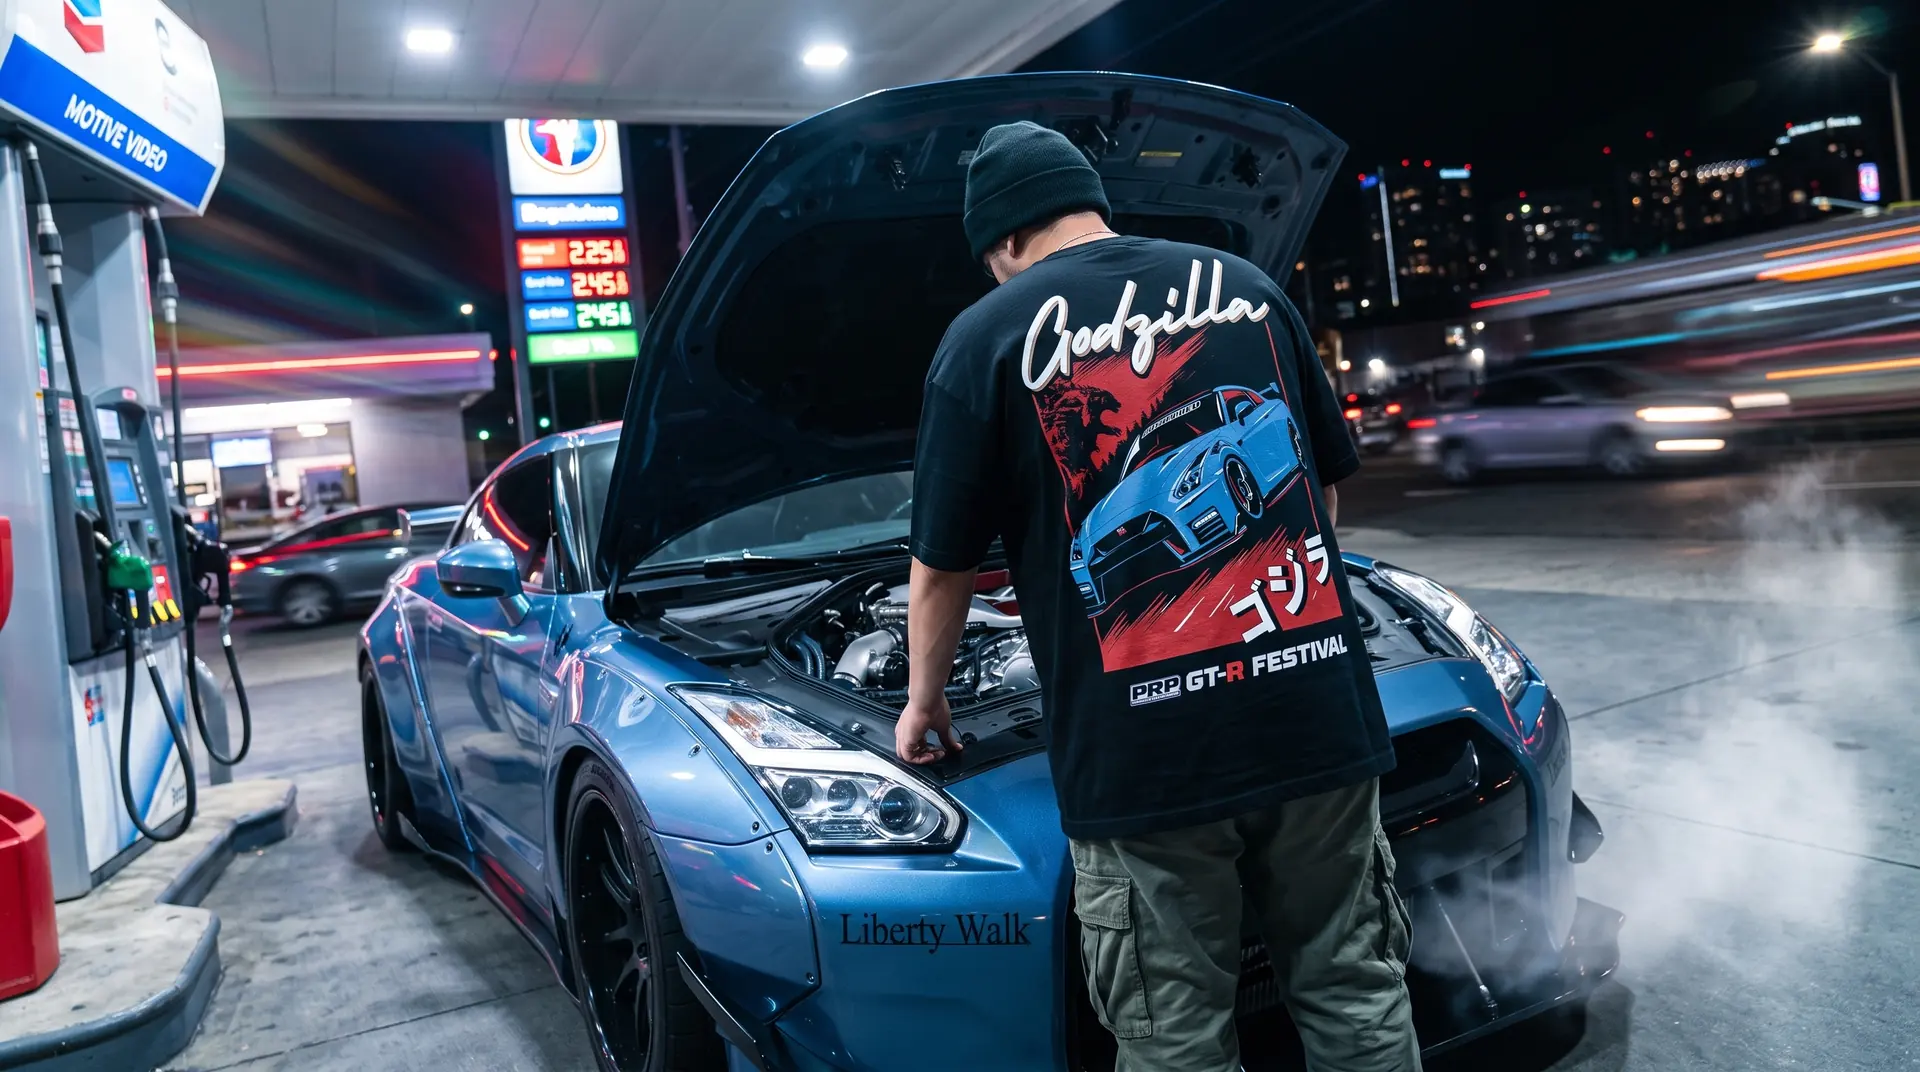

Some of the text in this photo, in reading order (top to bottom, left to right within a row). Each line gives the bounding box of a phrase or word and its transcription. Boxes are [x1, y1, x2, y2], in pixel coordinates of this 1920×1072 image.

[64, 94, 125, 149] MOTIVE
[125, 131, 168, 173] VIDEO
[1021, 258, 1270, 391] Godzilla
[1229, 533, 1330, 643] ゴジラ
[1131, 677, 1180, 701] PRP
[1185, 660, 1245, 692] GT-R
[1252, 634, 1348, 677] FESTIVAL
[840, 911, 1032, 954] Liberty Walk
